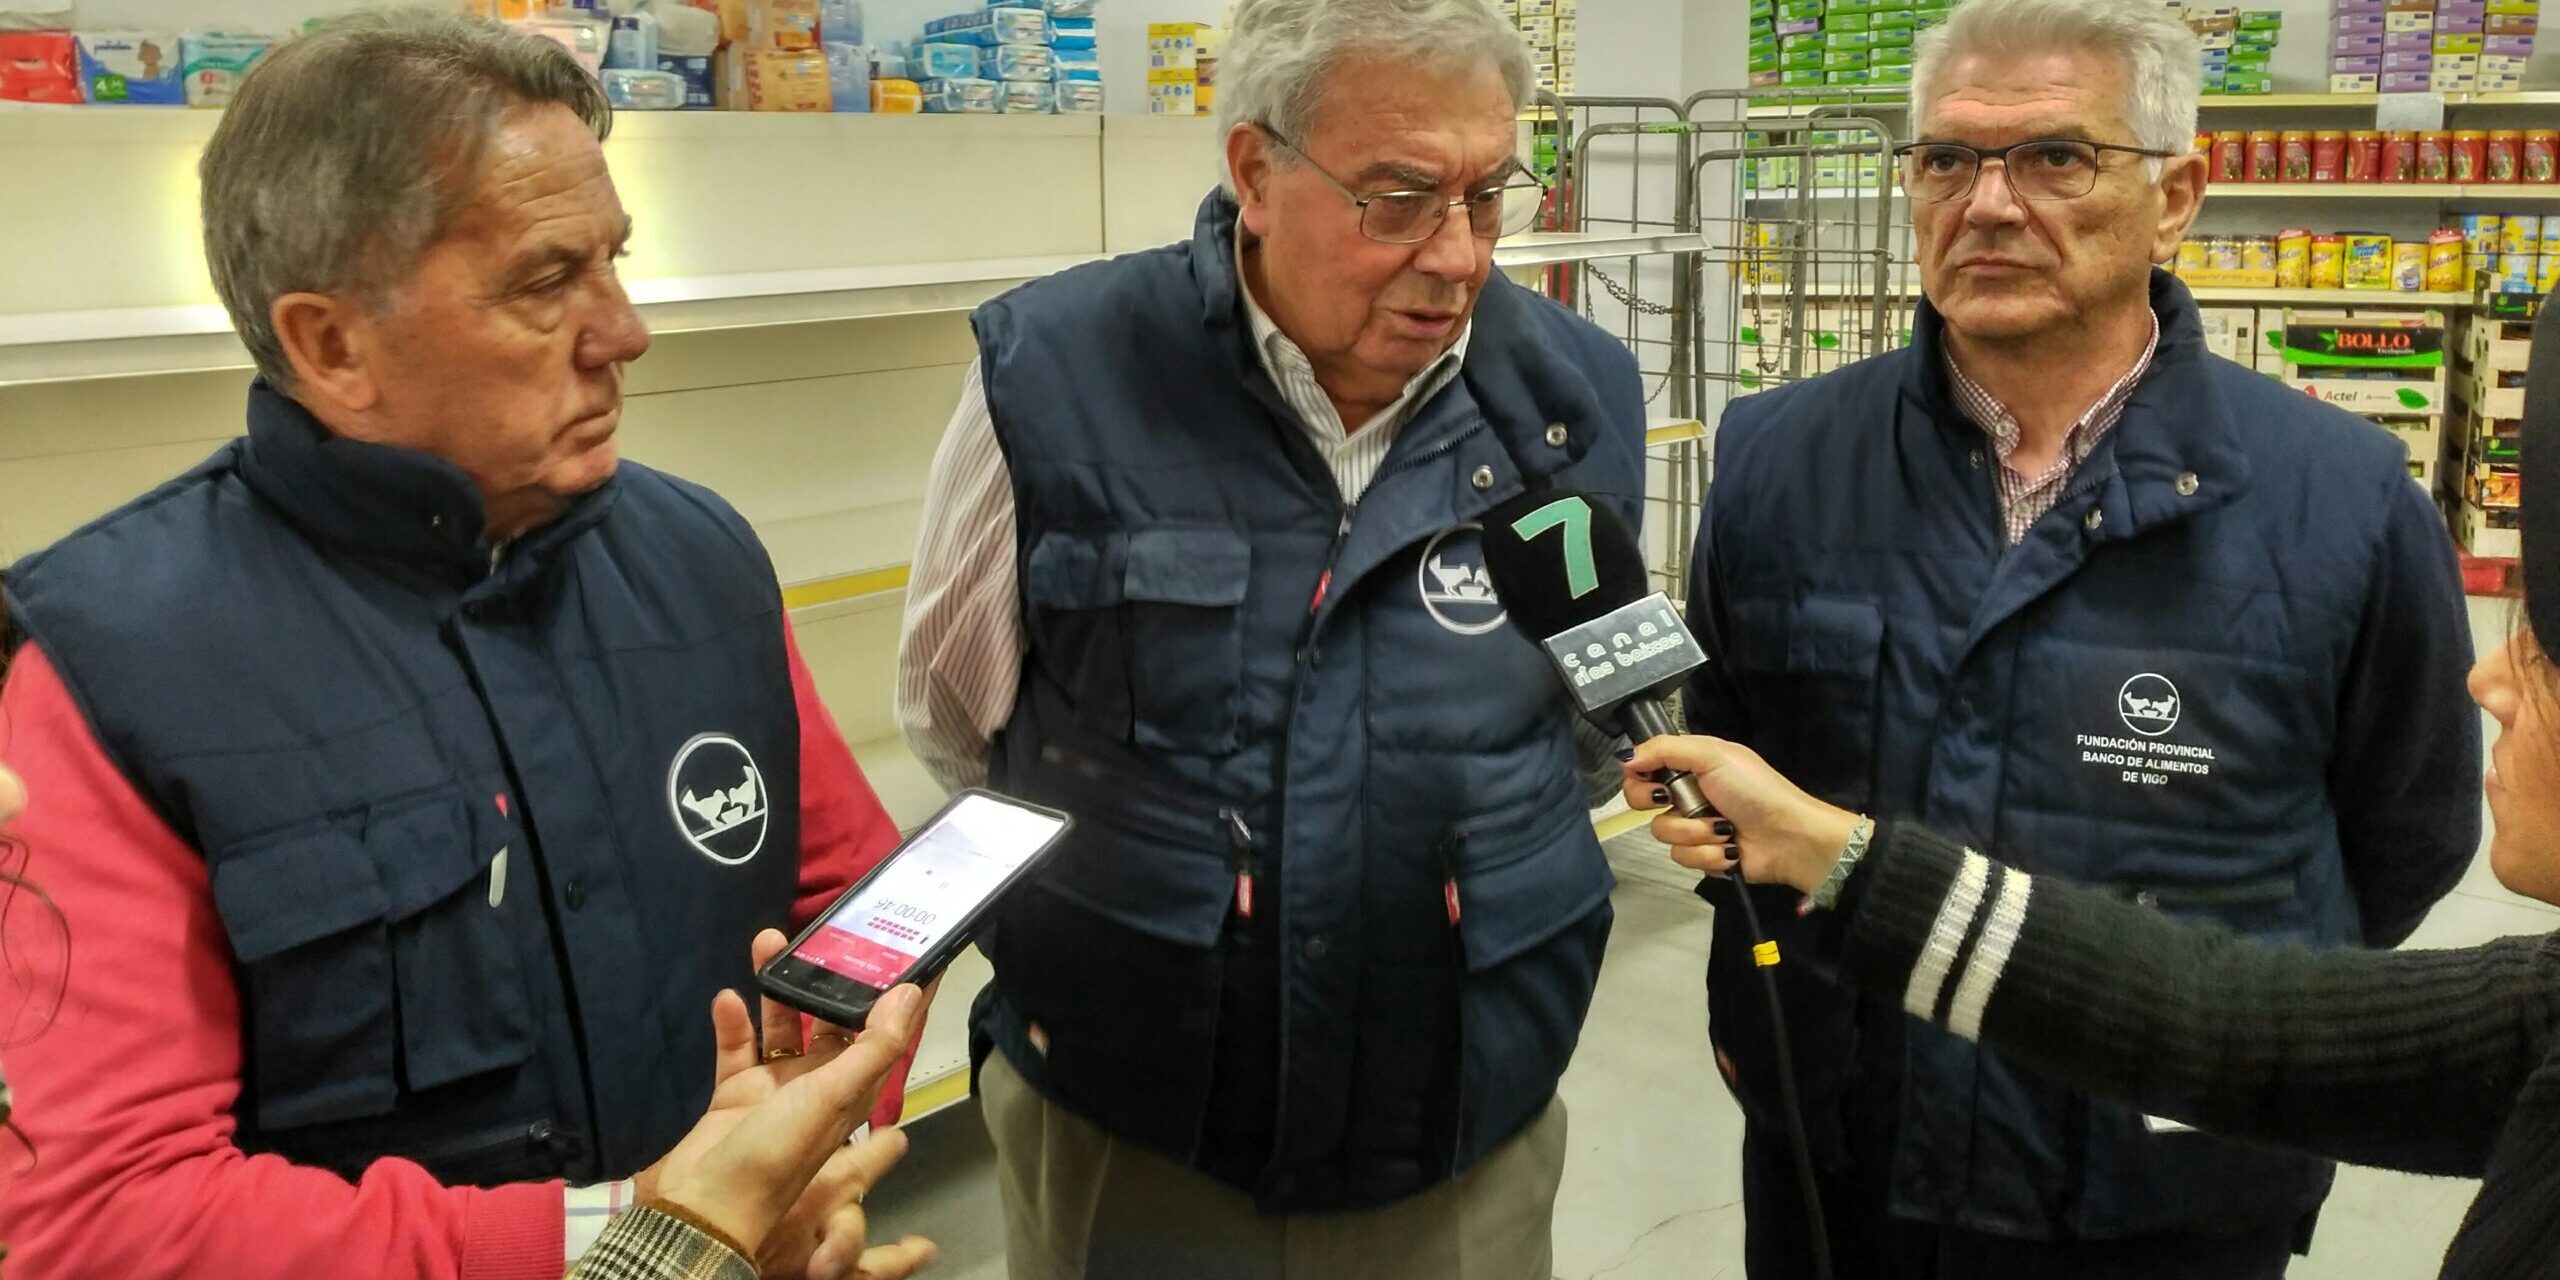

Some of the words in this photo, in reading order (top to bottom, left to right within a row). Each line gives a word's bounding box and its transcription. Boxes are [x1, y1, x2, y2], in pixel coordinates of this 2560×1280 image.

[2338, 332, 2410, 349] BOLLO
[2324, 391, 2358, 402] Actel
[1511, 496, 1600, 600] 7
[1613, 632, 1684, 667] baixas
[2077, 734, 2146, 752] FUNDACIÓN
[2149, 742, 2215, 760] PROVINCIAL
[2082, 751, 2125, 766] BANCO
[2127, 756, 2143, 768] DE
[2145, 758, 2209, 775] ALIMENTOS
[2122, 771, 2138, 783] DE
[2141, 773, 2169, 785] VIGO
